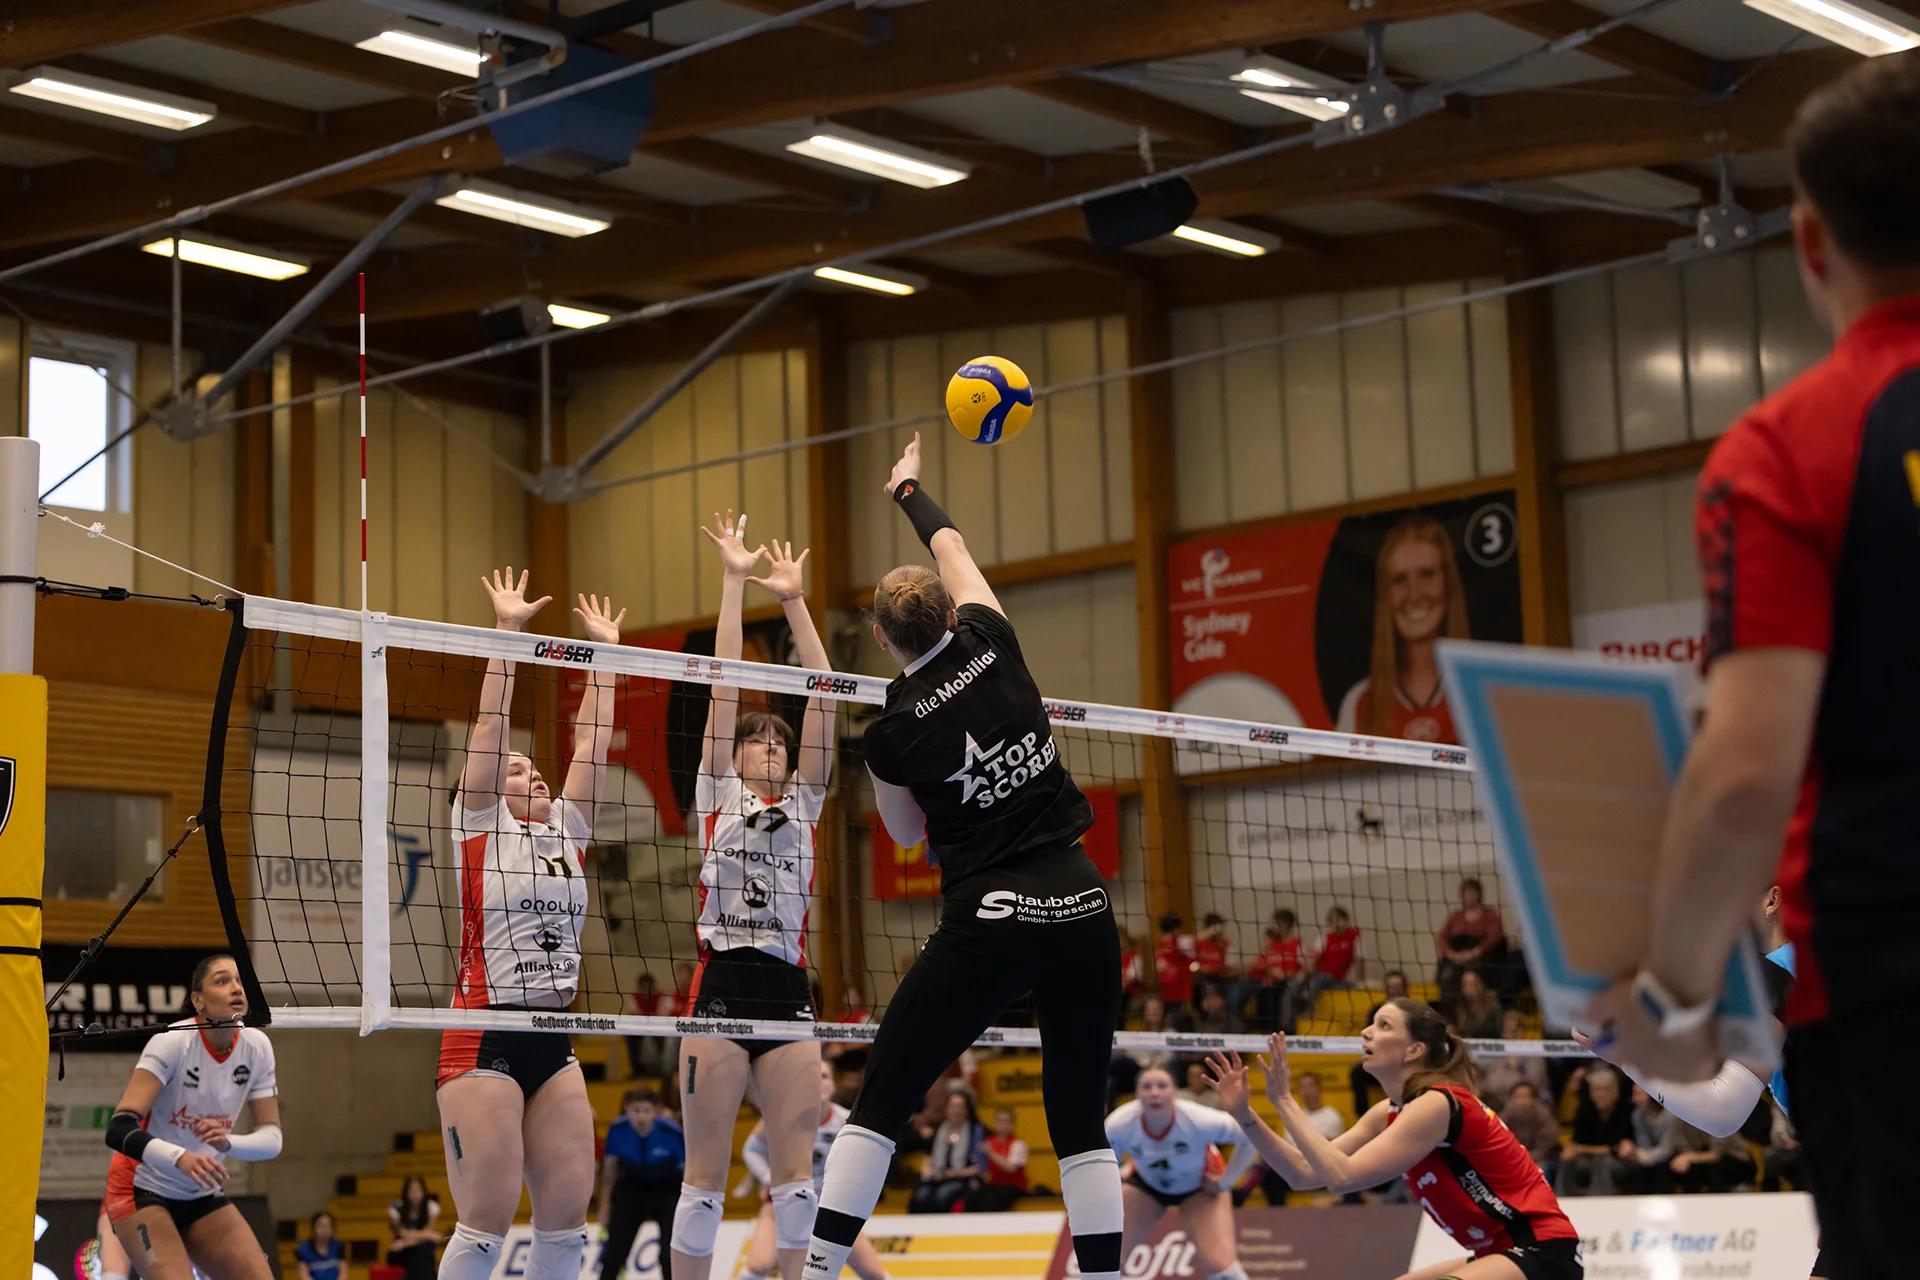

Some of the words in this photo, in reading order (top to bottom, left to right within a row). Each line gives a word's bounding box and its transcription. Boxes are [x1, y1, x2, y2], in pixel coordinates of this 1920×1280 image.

[1481, 514, 1503, 554] 3
[534, 640, 594, 664] GASSER
[806, 674, 858, 695] GASSER
[914, 696, 940, 719] die
[935, 649, 998, 703] Mobiliar
[984, 731, 1037, 780] TOP
[976, 890, 1080, 919] Stauber
[717, 913, 764, 929] Allianz
[514, 961, 562, 974] Allianz
[1722, 1228, 1757, 1252] AG
[806, 1261, 829, 1272] rima
